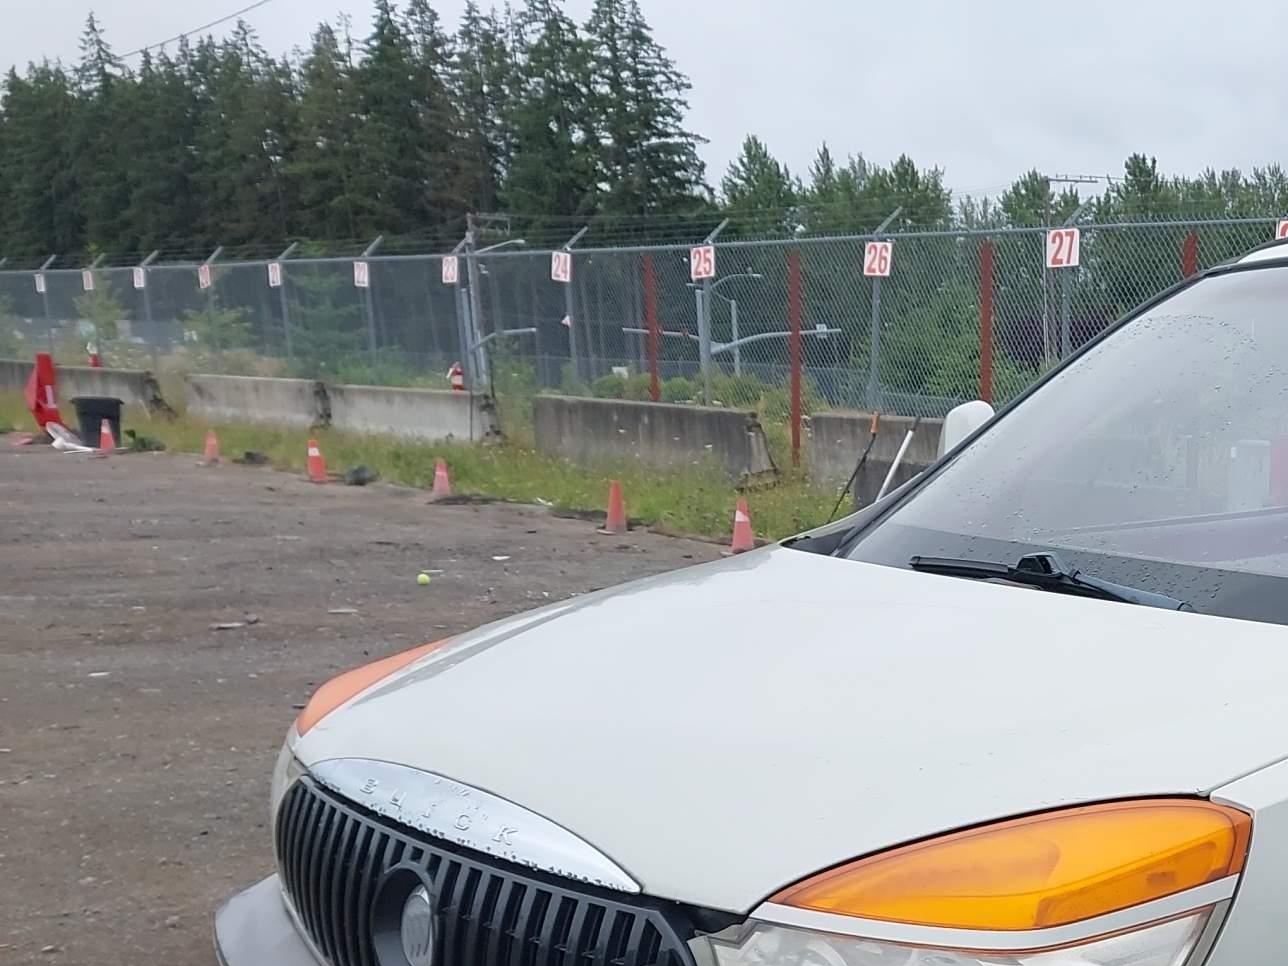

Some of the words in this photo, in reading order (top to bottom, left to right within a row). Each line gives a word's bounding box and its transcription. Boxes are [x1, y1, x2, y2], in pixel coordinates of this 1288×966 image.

[692, 248, 713, 276] 25
[866, 243, 889, 274] 26
[1050, 230, 1076, 265] 27
[552, 254, 569, 279] 24
[360, 777, 520, 847] BUICK
